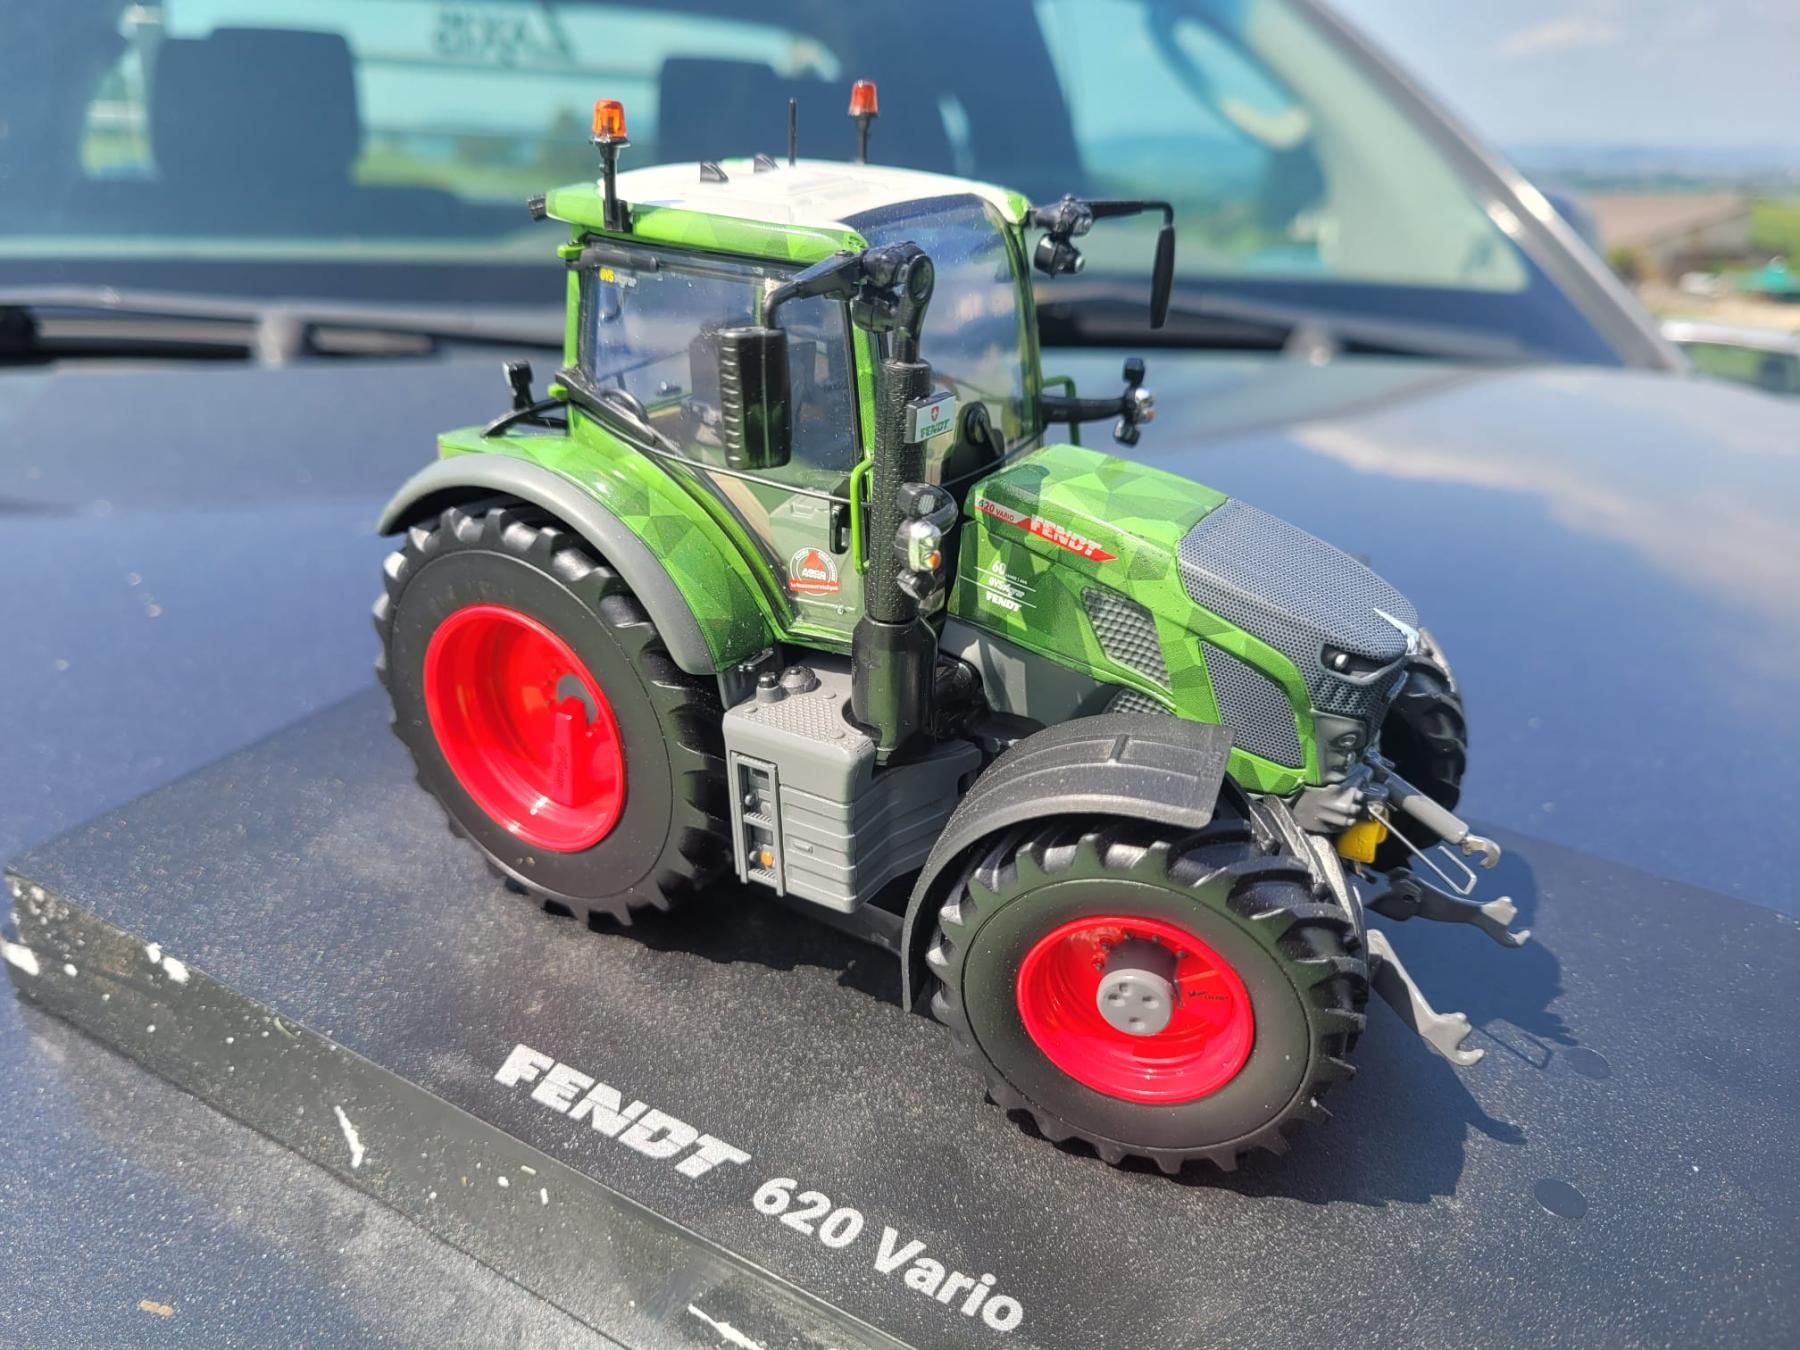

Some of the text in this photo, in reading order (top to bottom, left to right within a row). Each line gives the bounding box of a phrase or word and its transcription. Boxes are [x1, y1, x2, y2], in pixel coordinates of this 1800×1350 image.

[921, 419, 950, 438] FENDT
[978, 499, 1015, 521] 620 VARIO
[1030, 514, 1102, 556] FENDT
[992, 560, 1006, 576] 60
[986, 591, 1022, 612] FENDT
[494, 1043, 1024, 1333] FENDT 620 Vario
